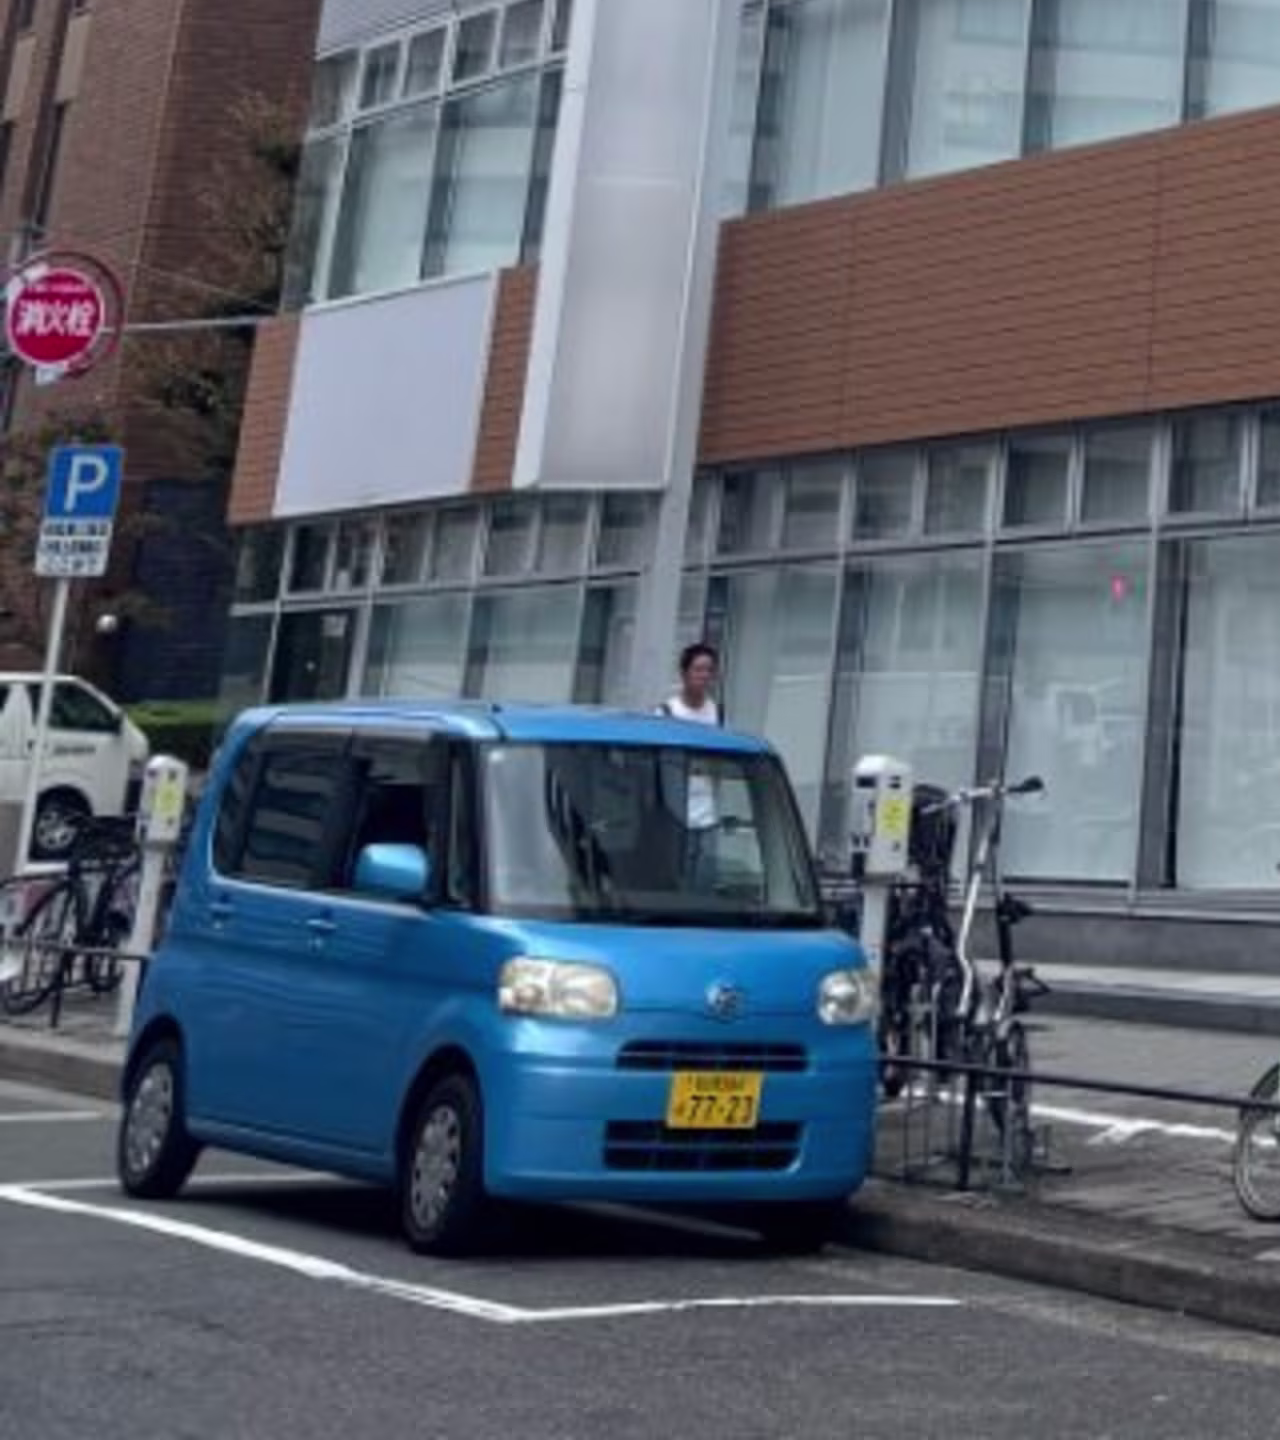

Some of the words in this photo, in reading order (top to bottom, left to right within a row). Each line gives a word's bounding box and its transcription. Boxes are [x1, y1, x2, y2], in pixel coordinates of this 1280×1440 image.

[15, 298, 96, 337] 消火栓
[64, 454, 109, 511] P
[688, 1094, 754, 1123] 77-23
